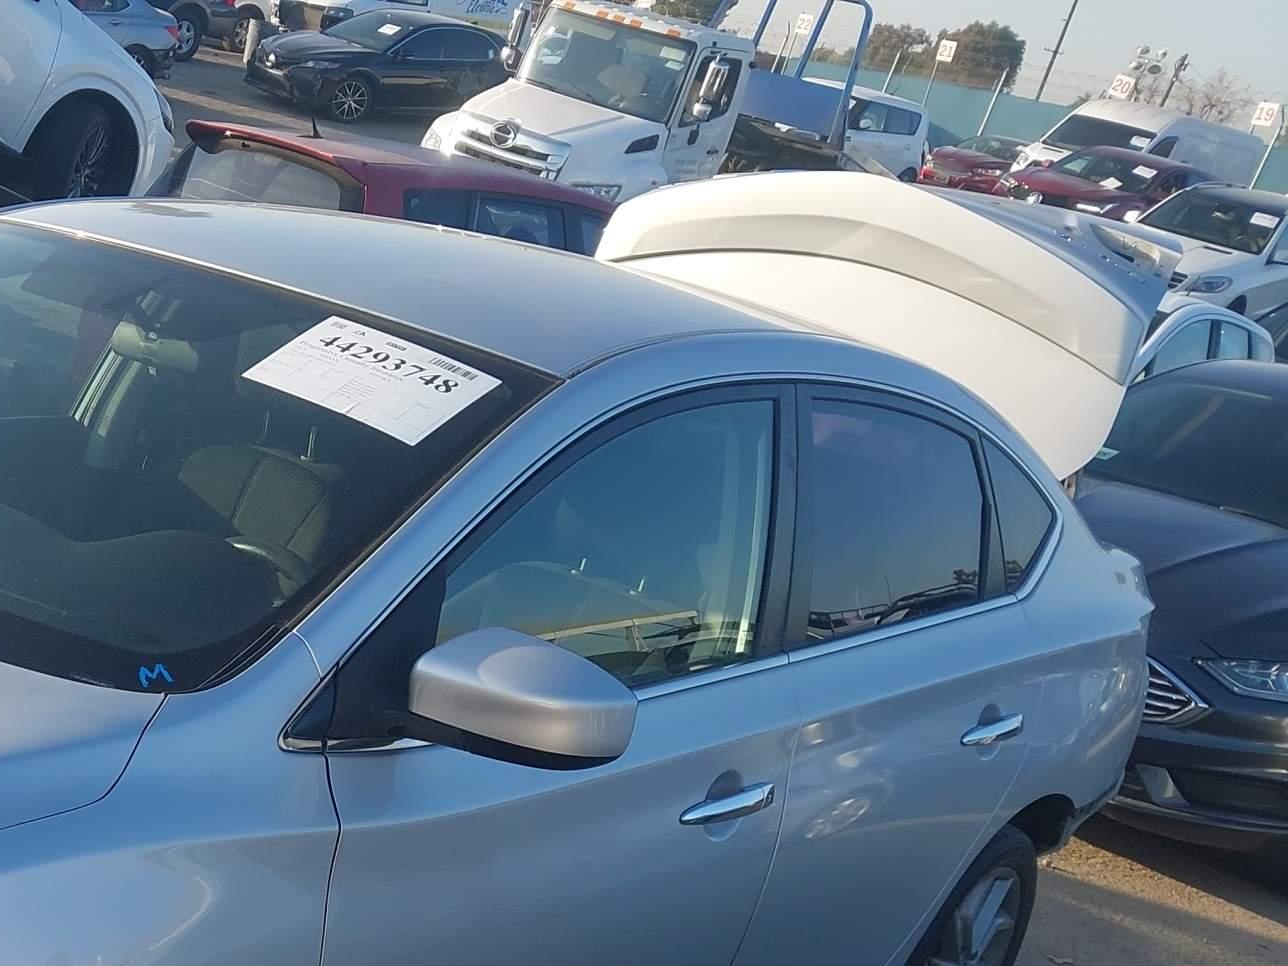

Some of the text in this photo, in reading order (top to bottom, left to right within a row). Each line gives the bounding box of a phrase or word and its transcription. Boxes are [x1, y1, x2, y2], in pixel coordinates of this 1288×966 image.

[797, 17, 812, 31] 22
[938, 43, 953, 58] 21
[1112, 78, 1131, 95] 20
[1254, 106, 1275, 122] 19
[319, 336, 459, 393] 44293748
[138, 663, 174, 688] M
